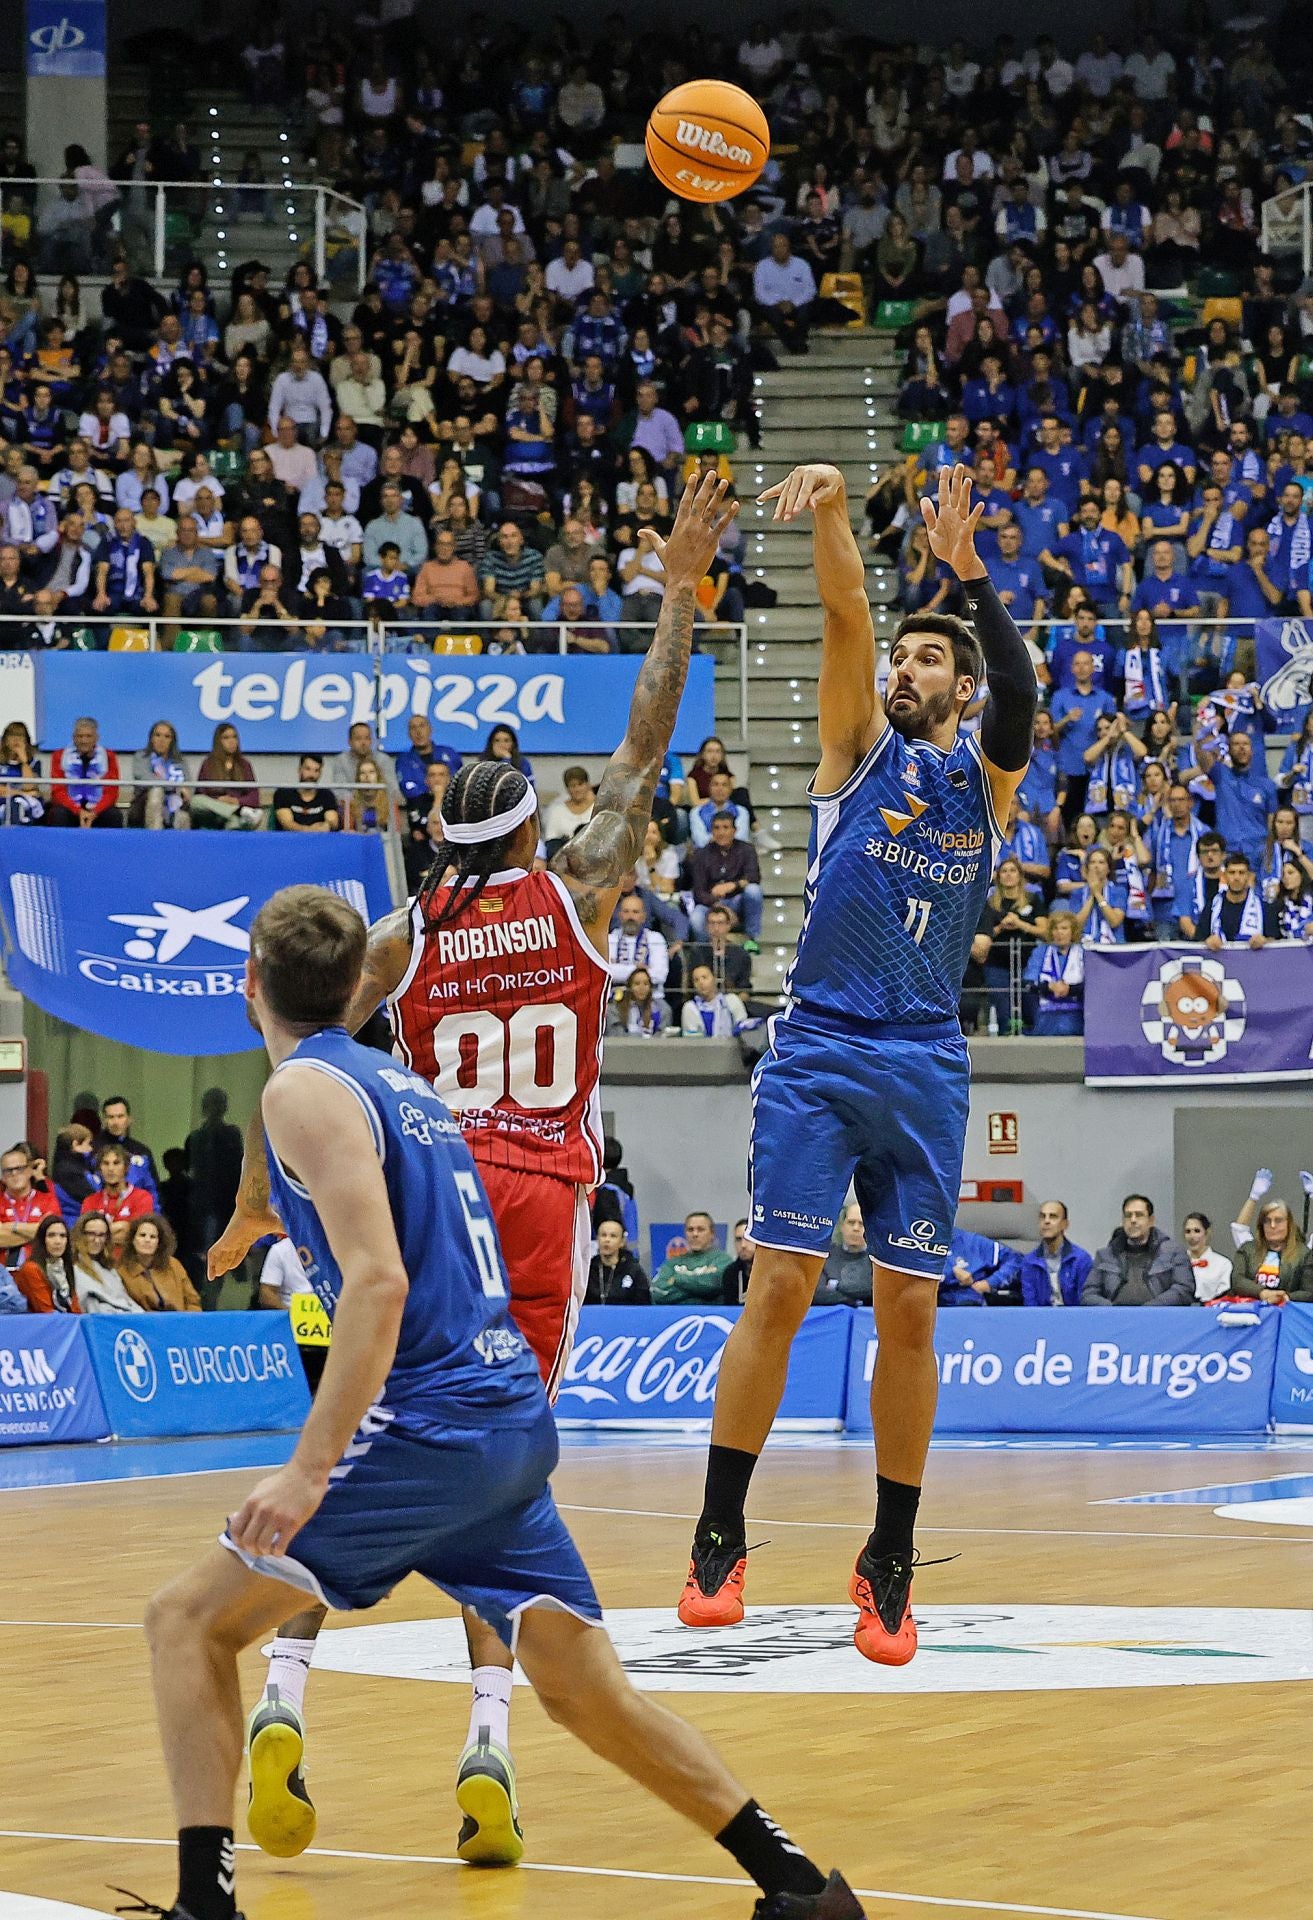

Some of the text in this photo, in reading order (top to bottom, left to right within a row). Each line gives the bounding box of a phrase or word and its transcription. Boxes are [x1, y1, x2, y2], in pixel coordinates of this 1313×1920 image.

[676, 119, 753, 166] Wilson
[192, 659, 565, 738] telepizza
[438, 915, 557, 964] ROBINSON
[903, 897, 932, 945] 11
[428, 965, 574, 1000] AIR HORIZONT
[433, 1002, 578, 1110] 00
[453, 1171, 506, 1298] 6
[772, 1209, 808, 1221] CASTILLA
[811, 1215, 818, 1224] Y
[887, 1233, 949, 1256] LEXUS
[168, 1343, 293, 1386] BURGOCAR
[563, 1314, 737, 1402] ca-Col
[1014, 1338, 1073, 1386] de
[1087, 1342, 1253, 1399] Burgos
